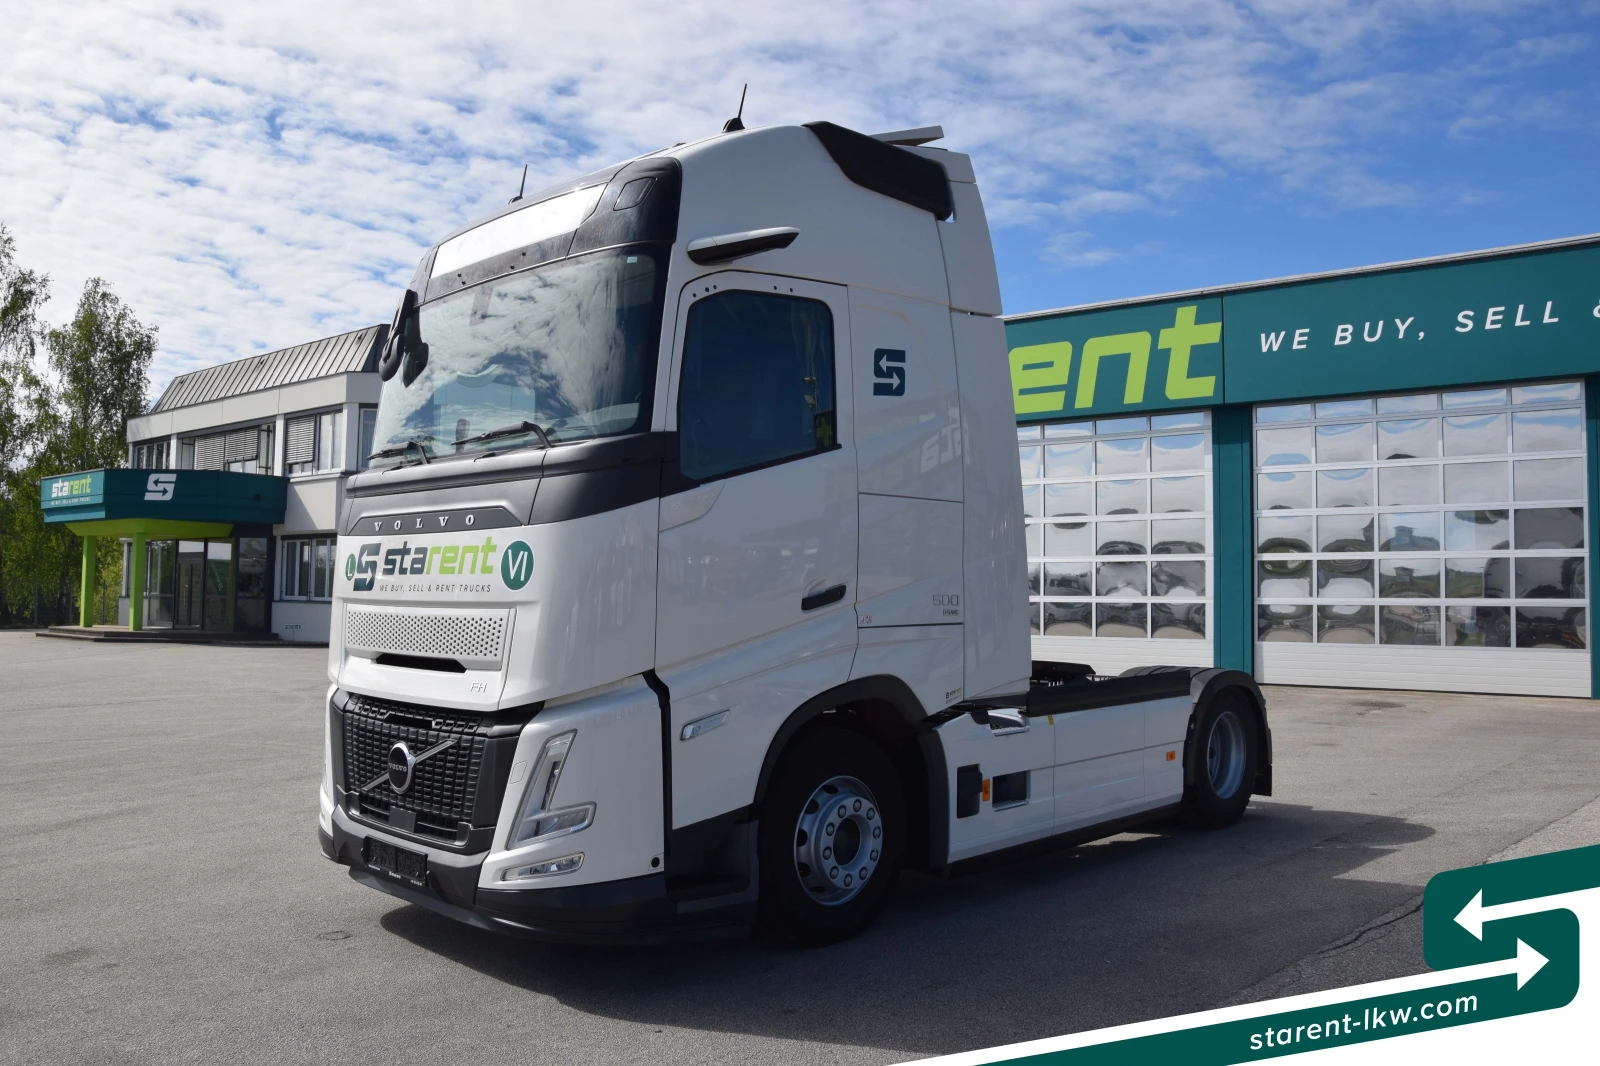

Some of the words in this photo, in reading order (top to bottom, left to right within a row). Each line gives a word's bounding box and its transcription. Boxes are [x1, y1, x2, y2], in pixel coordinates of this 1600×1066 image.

[1260, 327, 1310, 353] WE
[1334, 316, 1426, 346] BUY,
[1455, 301, 1560, 333] SELL
[51, 475, 91, 497] starent
[374, 514, 476, 532] VOLVO
[382, 537, 497, 575] starent
[508, 548, 528, 582] VI
[379, 584, 389, 592] WE
[391, 584, 405, 593] BUY,
[408, 584, 424, 592] SELL
[435, 584, 456, 592] RENT
[459, 584, 492, 593] TRUCKS
[932, 594, 959, 606] 500
[470, 681, 487, 693] FH
[388, 762, 408, 773] VOLVO
